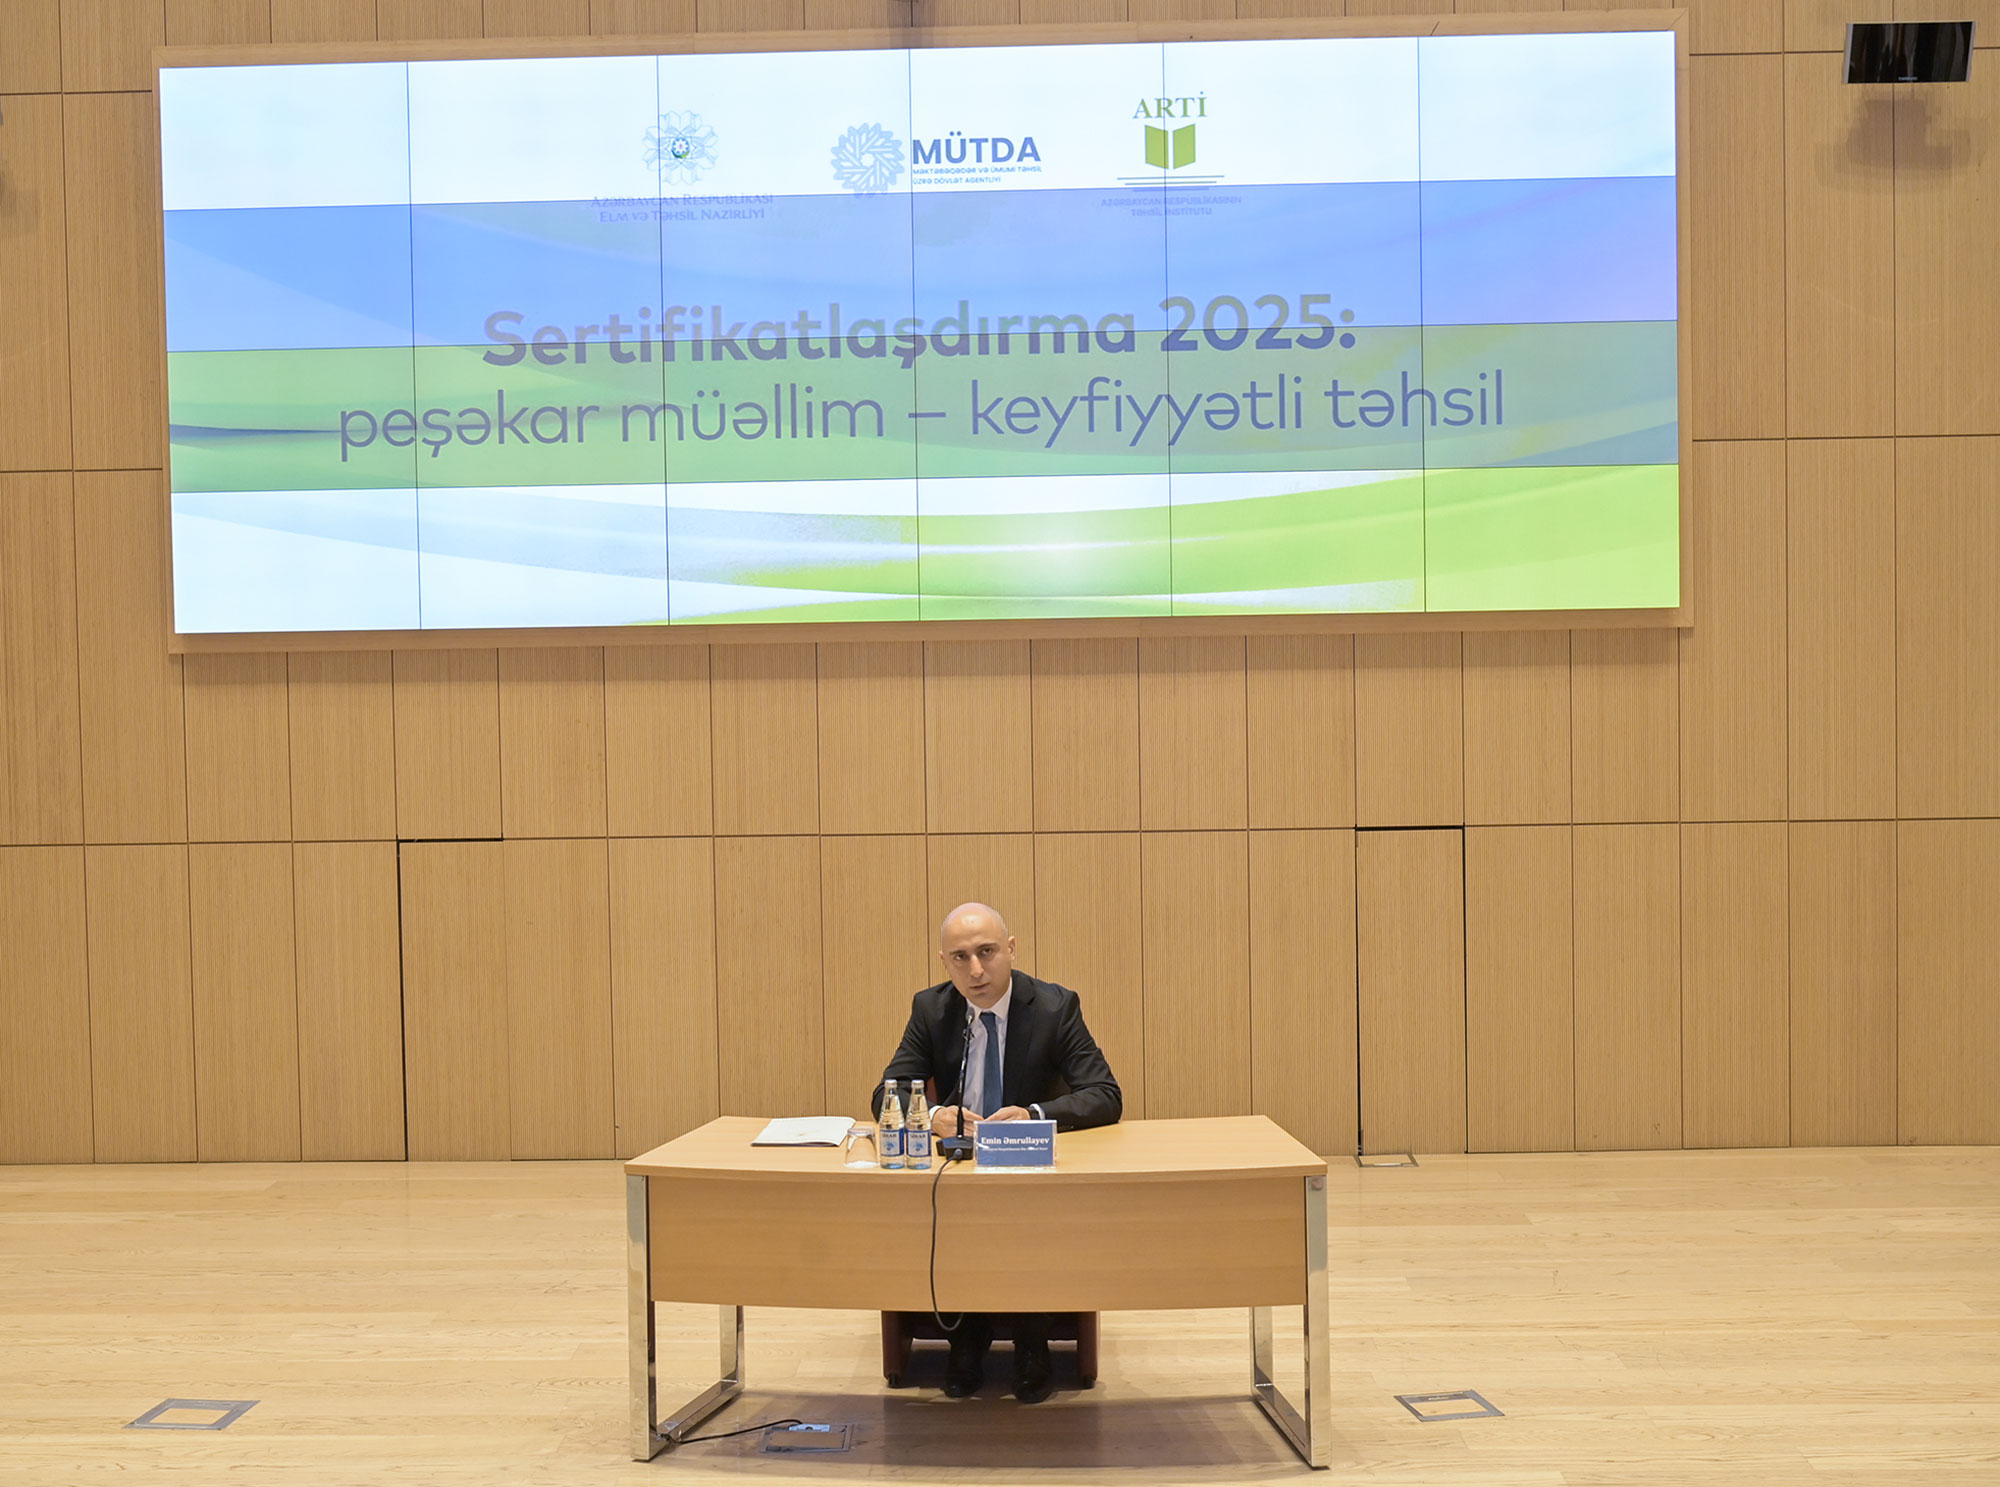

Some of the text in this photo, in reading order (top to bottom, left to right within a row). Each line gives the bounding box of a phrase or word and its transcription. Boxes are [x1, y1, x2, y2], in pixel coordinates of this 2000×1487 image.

[1132, 91, 1208, 119] ARTİ
[912, 131, 1042, 165] MÜTDA
[600, 211, 629, 223] ELM
[652, 209, 698, 222] TƏHSİL
[1164, 206, 1213, 216] NSTİTUTU
[482, 293, 1357, 370] Sertifikatlaşdırma 2025:
[340, 388, 600, 463] peşəkar
[621, 382, 885, 444] müəllim
[970, 372, 1302, 449] keyfiyyətli
[1323, 368, 1504, 428] təhsil
[981, 1135, 1050, 1146] Emin Əmrullayev
